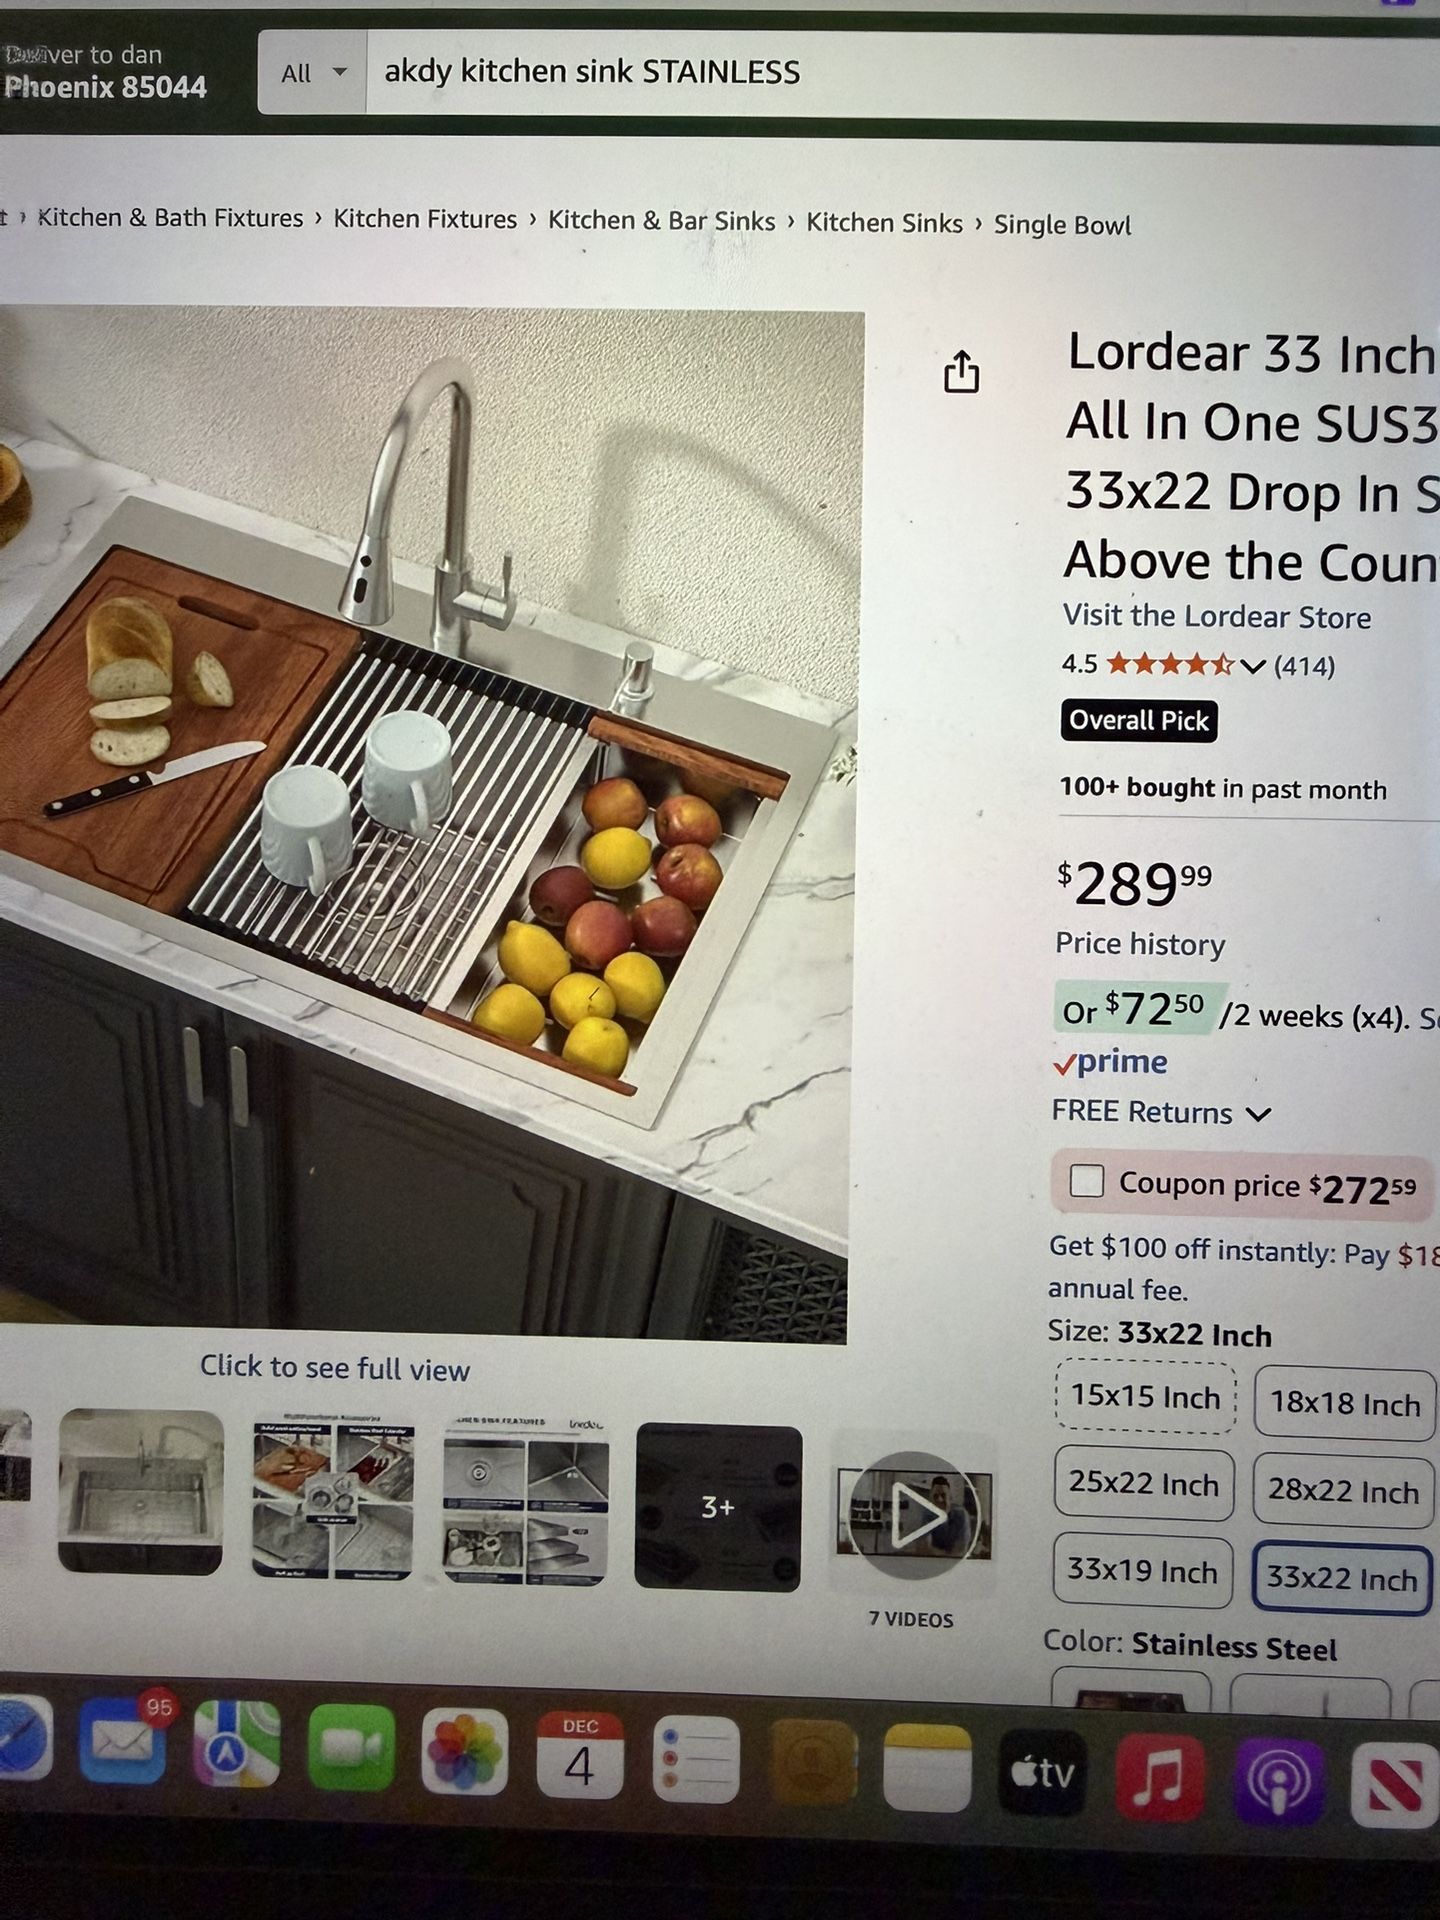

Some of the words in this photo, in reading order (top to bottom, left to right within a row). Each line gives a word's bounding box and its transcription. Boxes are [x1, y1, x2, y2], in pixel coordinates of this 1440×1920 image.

[90, 46, 112, 64] to
[122, 44, 161, 64] dan
[5, 74, 114, 98] Phoenix
[122, 75, 207, 98] 85044
[282, 64, 311, 82] All
[386, 57, 449, 88] akdy
[462, 57, 566, 82] kitchen
[577, 58, 633, 83] sink
[644, 59, 800, 84] STAINLESS
[38, 207, 121, 226] Kitchen
[130, 208, 147, 226] &
[156, 207, 206, 226] Bath
[216, 208, 303, 227] Fixtures
[335, 208, 419, 228] Kitchen
[429, 209, 517, 229] Fixtures
[550, 209, 634, 229] Kitchen
[643, 210, 661, 230] &
[670, 211, 708, 230] Bar
[716, 211, 775, 231] Sinks
[808, 212, 893, 232] Kitchen
[903, 213, 963, 233] Sinks
[995, 214, 1066, 239] Single
[1076, 215, 1131, 235] Bowl
[1071, 331, 1250, 371] Lordear
[1265, 335, 1320, 373] 33
[1342, 334, 1434, 374] Inch
[1066, 399, 1129, 439] All
[1147, 402, 1186, 439] In
[1205, 402, 1299, 442] One
[1318, 404, 1438, 444] SUS3
[1067, 471, 1210, 509] 33x22
[1230, 473, 1340, 522] Drop
[1360, 475, 1397, 512] In
[1063, 538, 1210, 580] Above
[1225, 540, 1302, 581] the
[1321, 544, 1440, 582] Coun
[1063, 603, 1122, 626] Visit
[1130, 603, 1175, 626] the
[1186, 604, 1291, 628] Lordear
[1300, 606, 1371, 629] Store
[1062, 654, 1097, 673] 4.5
[1275, 655, 1334, 680] (414)
[1070, 709, 1154, 730] Overall
[1162, 710, 1209, 731] Pick
[1061, 777, 1119, 796] 100+
[1128, 776, 1215, 802] bought
[1224, 778, 1243, 797] in
[1252, 781, 1301, 803] past
[1310, 780, 1386, 800] month
[1057, 931, 1121, 954] Price
[1131, 932, 1226, 962] history
[1064, 1002, 1097, 1024] Or
[1219, 1002, 1250, 1029] /2
[1259, 1004, 1343, 1028] weeks
[1353, 1004, 1409, 1033] (x4).
[1079, 1047, 1167, 1078] prime
[1053, 1099, 1119, 1121] FREE
[1130, 1101, 1232, 1124] Returns
[1120, 1171, 1224, 1200] Coupon
[1235, 1175, 1300, 1201] price
[1050, 1235, 1094, 1256] Get
[1102, 1233, 1166, 1260] $100
[1175, 1238, 1211, 1259] off
[1219, 1240, 1335, 1268] instantly:
[1346, 1244, 1390, 1271] Pay
[1049, 1278, 1134, 1299] annual
[1142, 1279, 1188, 1301] fee.
[1049, 1319, 1108, 1342] Size:
[1119, 1321, 1203, 1345] 33x22
[1214, 1324, 1271, 1347] Inch
[201, 1353, 262, 1376] Click
[270, 1357, 297, 1377] to
[306, 1362, 349, 1379] see
[357, 1357, 401, 1380] full
[410, 1359, 470, 1382] view
[1072, 1384, 1153, 1407] 15x15
[1165, 1386, 1220, 1409] Inch
[1272, 1390, 1354, 1415] 18x18
[1365, 1394, 1420, 1417] Inch
[1070, 1470, 1153, 1494] 25x22
[1164, 1473, 1218, 1497] Inch
[1269, 1477, 1352, 1502] 28x22
[1363, 1481, 1419, 1504] Inch
[702, 1496, 734, 1518] 3+
[1068, 1557, 1151, 1582] 33x19
[1162, 1561, 1217, 1584] Inch
[1268, 1565, 1351, 1589] 33x22
[1362, 1569, 1417, 1592] Inch
[869, 1611, 879, 1625] 7
[885, 1611, 953, 1628] VIDEOS
[1044, 1629, 1122, 1653] Color:
[1133, 1632, 1257, 1658] Stainless
[1267, 1638, 1337, 1661] Steel
[147, 1699, 172, 1716] 95
[564, 1720, 598, 1733] DEC
[565, 1747, 594, 1785] 4
[1040, 1759, 1075, 1788] tv
